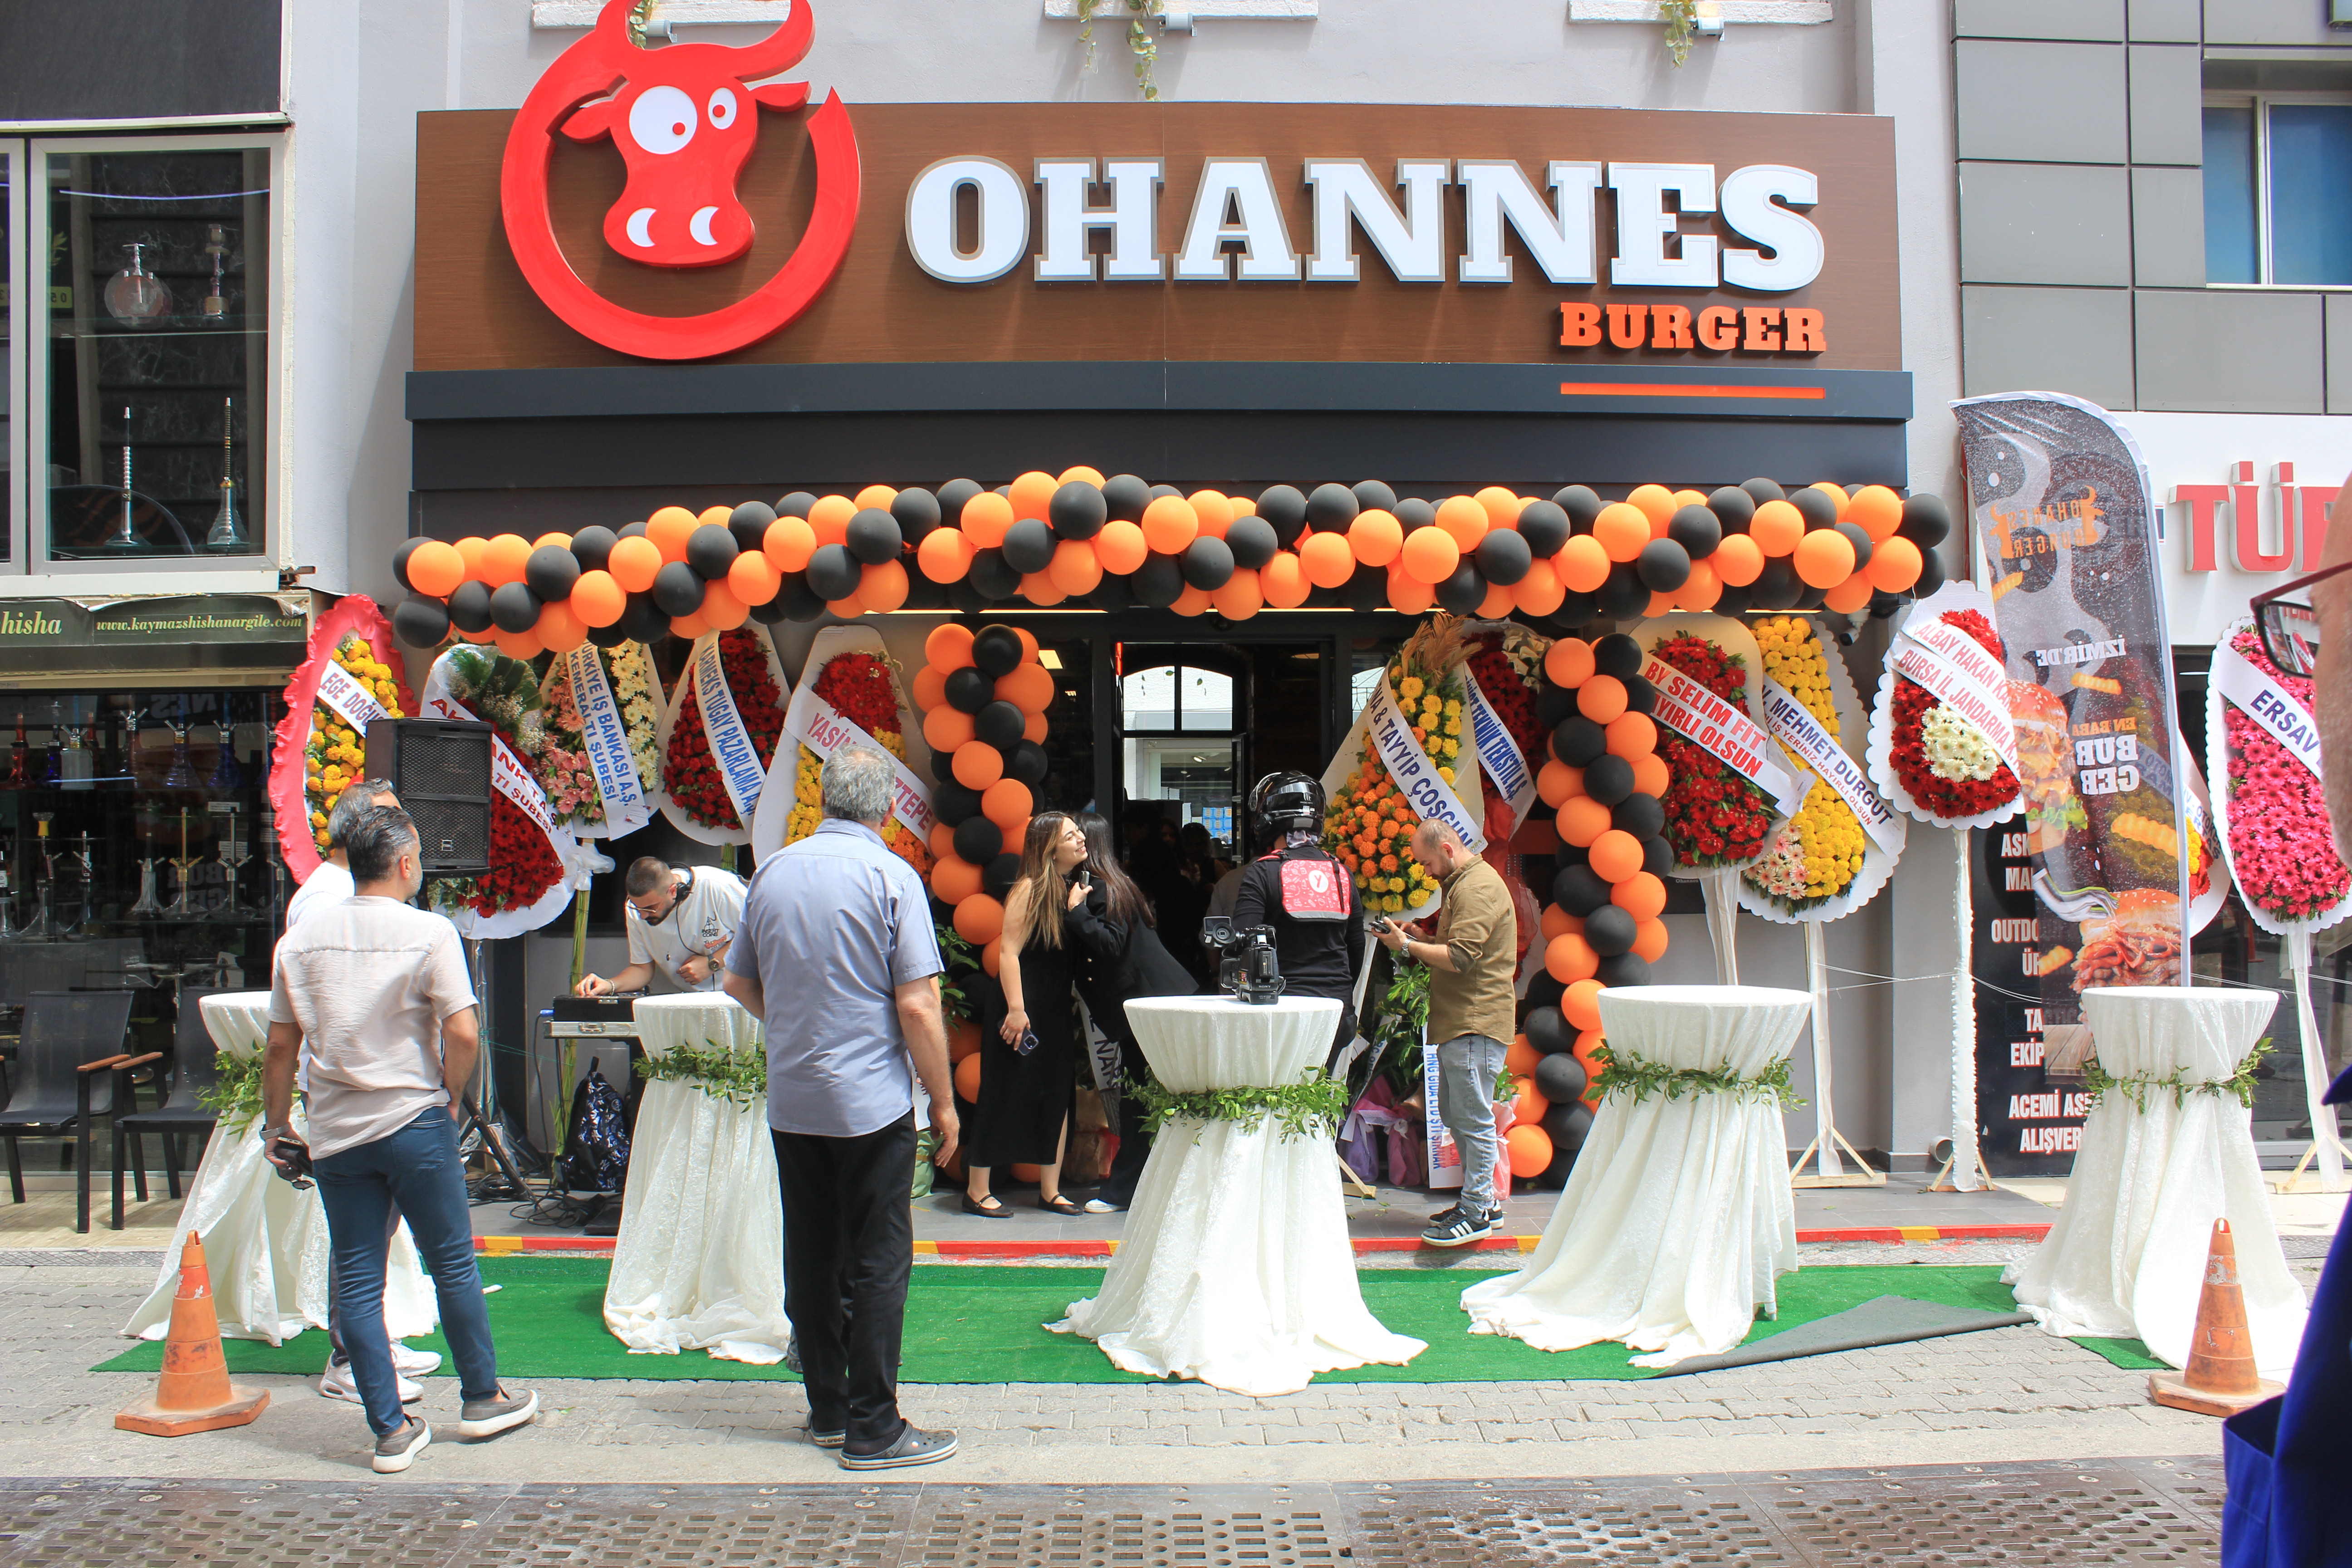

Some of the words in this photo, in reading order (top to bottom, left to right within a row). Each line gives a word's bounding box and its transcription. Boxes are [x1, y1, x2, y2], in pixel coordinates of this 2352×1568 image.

[905, 156, 1824, 291] OHANNES
[1559, 302, 1827, 353] BURGER
[0, 611, 62, 635] hisha
[96, 614, 303, 633] www.kaymazshishanargile.com
[699, 642, 721, 696] KARMEKS
[1915, 623, 1960, 655] ALBAY
[1951, 644, 1999, 689] HAKAN
[320, 672, 352, 700] EGE
[591, 695, 608, 711] İŞ
[705, 689, 735, 730] TUGAY
[1644, 661, 1672, 686] BY
[1667, 676, 1733, 727] SELİM
[1730, 718, 1766, 750] FİT
[1898, 649, 1941, 686] BURSA
[1935, 671, 1953, 697] İL
[1949, 687, 2010, 749] JANDARMA
[598, 713, 631, 778] BANKASI
[1378, 719, 1420, 777] TAYYİP
[2250, 689, 2320, 753] ERSAV
[589, 741, 618, 800] ŞUBESİ
[715, 726, 762, 796] PAZARLAMA
[1483, 737, 1525, 785] TEKSTİL
[1699, 726, 1763, 778] OLSUN
[1769, 697, 1837, 761] MEHMET
[1833, 759, 1893, 825] DURGUT
[1783, 730, 1820, 762] YERİNİZ
[1817, 761, 1849, 795] HAYIRLI
[1848, 795, 1873, 826] OLSUN
[2009, 1088, 2061, 1119] ACEMİ
[2019, 1122, 2087, 1155] ALIŞVER
